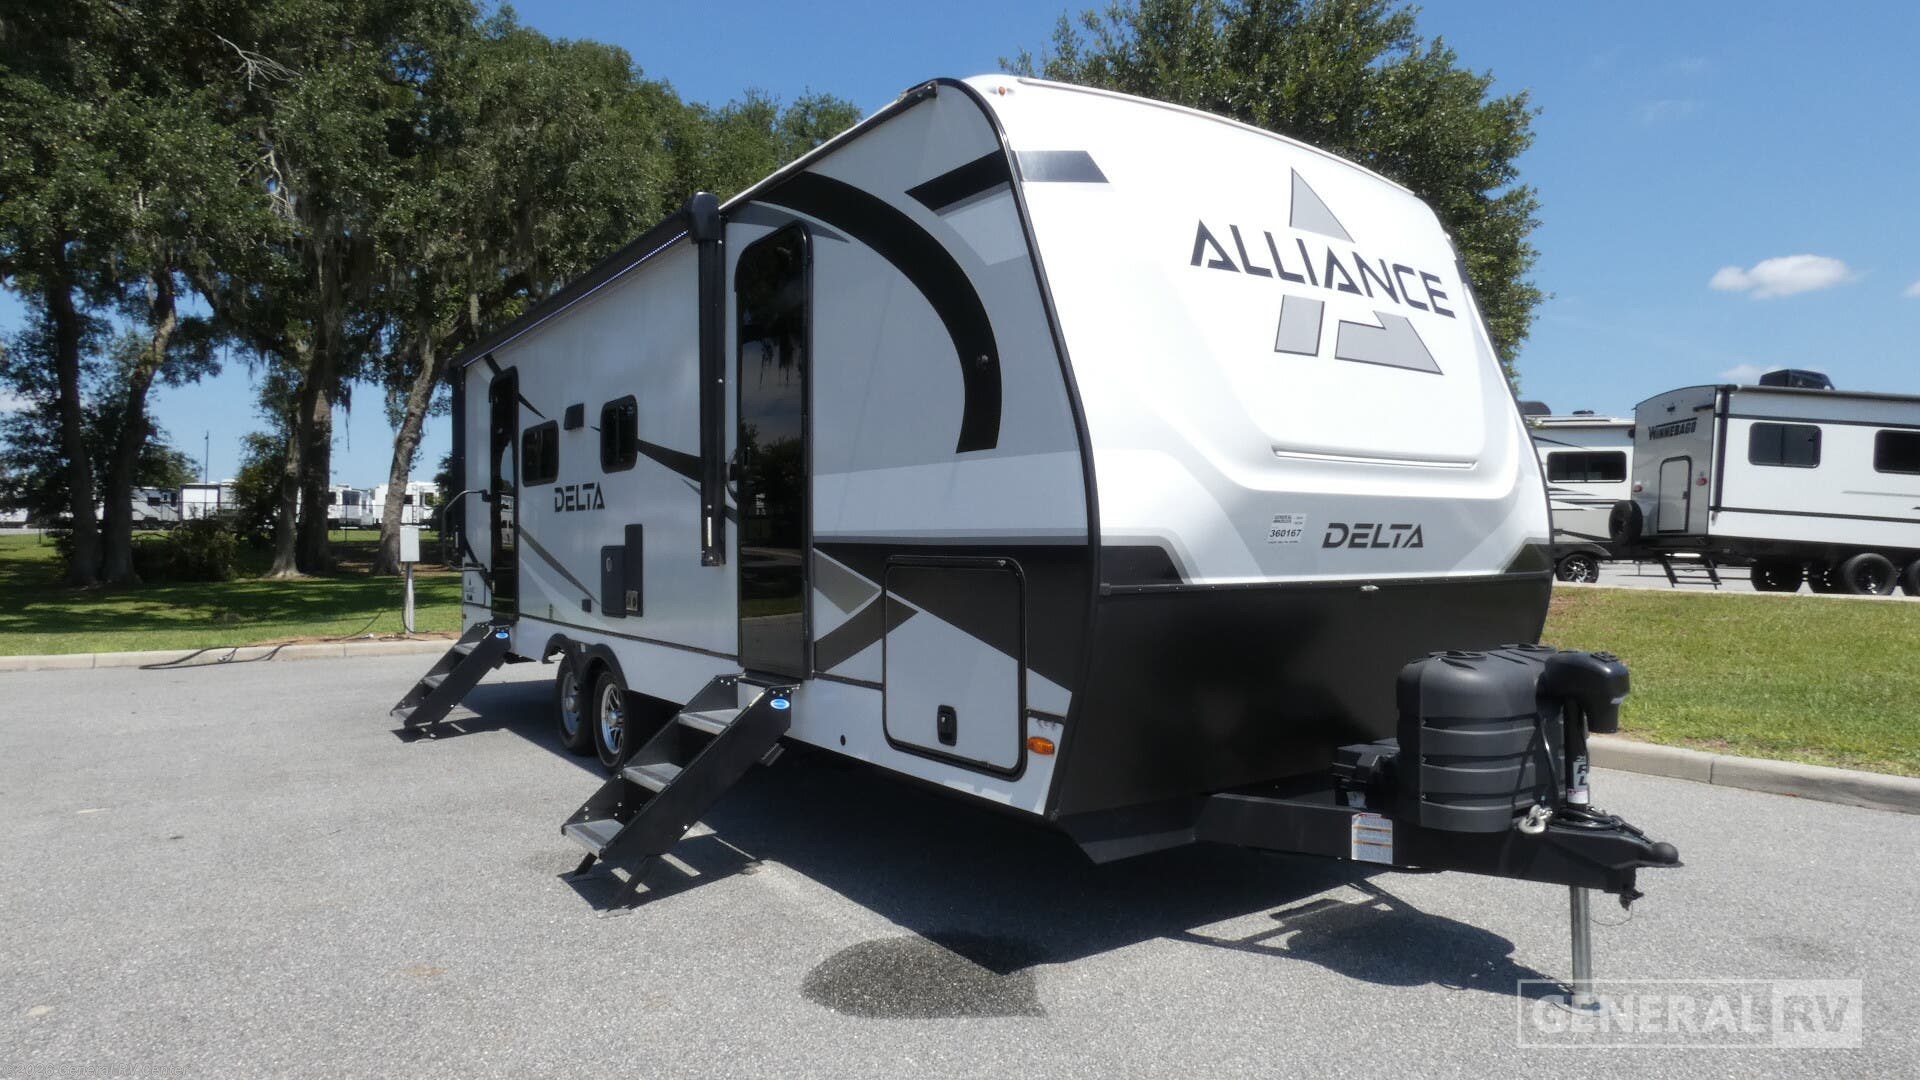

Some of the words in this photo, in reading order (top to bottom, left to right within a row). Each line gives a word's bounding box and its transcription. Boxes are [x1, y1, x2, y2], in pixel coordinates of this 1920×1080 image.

[1190, 218, 1456, 319] ALLIANCE
[554, 481, 606, 512] DELTA
[1269, 529, 1302, 538] 360167
[1321, 522, 1424, 549] DELTA
